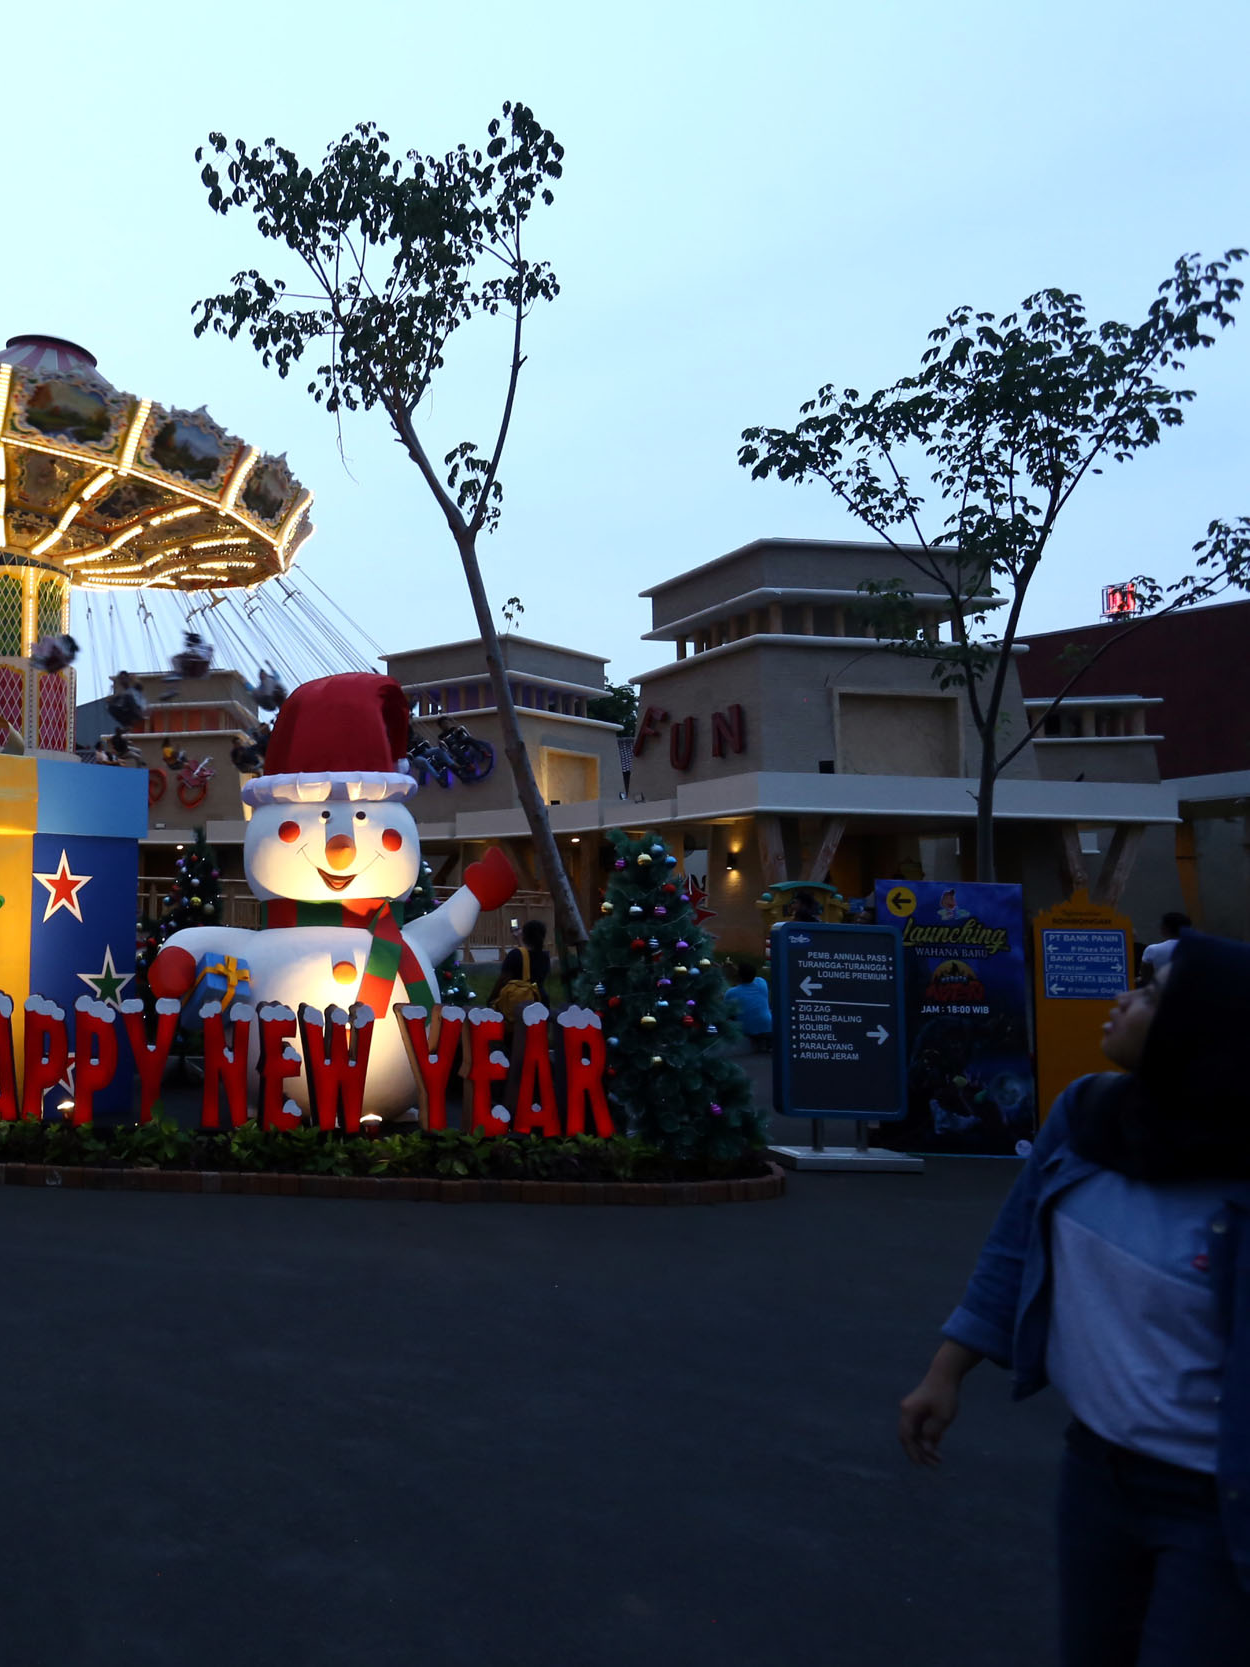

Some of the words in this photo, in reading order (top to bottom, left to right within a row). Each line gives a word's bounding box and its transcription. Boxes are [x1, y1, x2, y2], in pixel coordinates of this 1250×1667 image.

[633, 703, 743, 770] FUN
[902, 916, 1010, 955] Launching
[1048, 934, 1061, 942] PT
[1063, 934, 1089, 942] BANK
[807, 951, 832, 960] PEMB.
[833, 952, 866, 961] ANNUAL
[866, 954, 887, 962] PASS
[914, 946, 958, 958] WAHANA
[961, 948, 988, 959] BARU
[797, 960, 887, 972] TURANGGA-TURANGGA
[817, 970, 850, 979] LOUNGE
[852, 972, 887, 981] PREMIUM
[798, 1004, 813, 1012] ZIG
[814, 1005, 831, 1013] ZAG
[920, 1004, 940, 1014] JAM
[972, 1005, 990, 1015] WIB
[798, 1014, 862, 1023] BALING-BALING
[798, 1023, 832, 1032] KOLIBRI
[799, 1033, 837, 1041] KARAVEL
[799, 1042, 854, 1051] PARALAYANG
[799, 1052, 829, 1060] ARUNG
[830, 1053, 860, 1061] JERAM
[198, 1000, 375, 1133] NEW
[398, 1001, 616, 1138] YEAR
